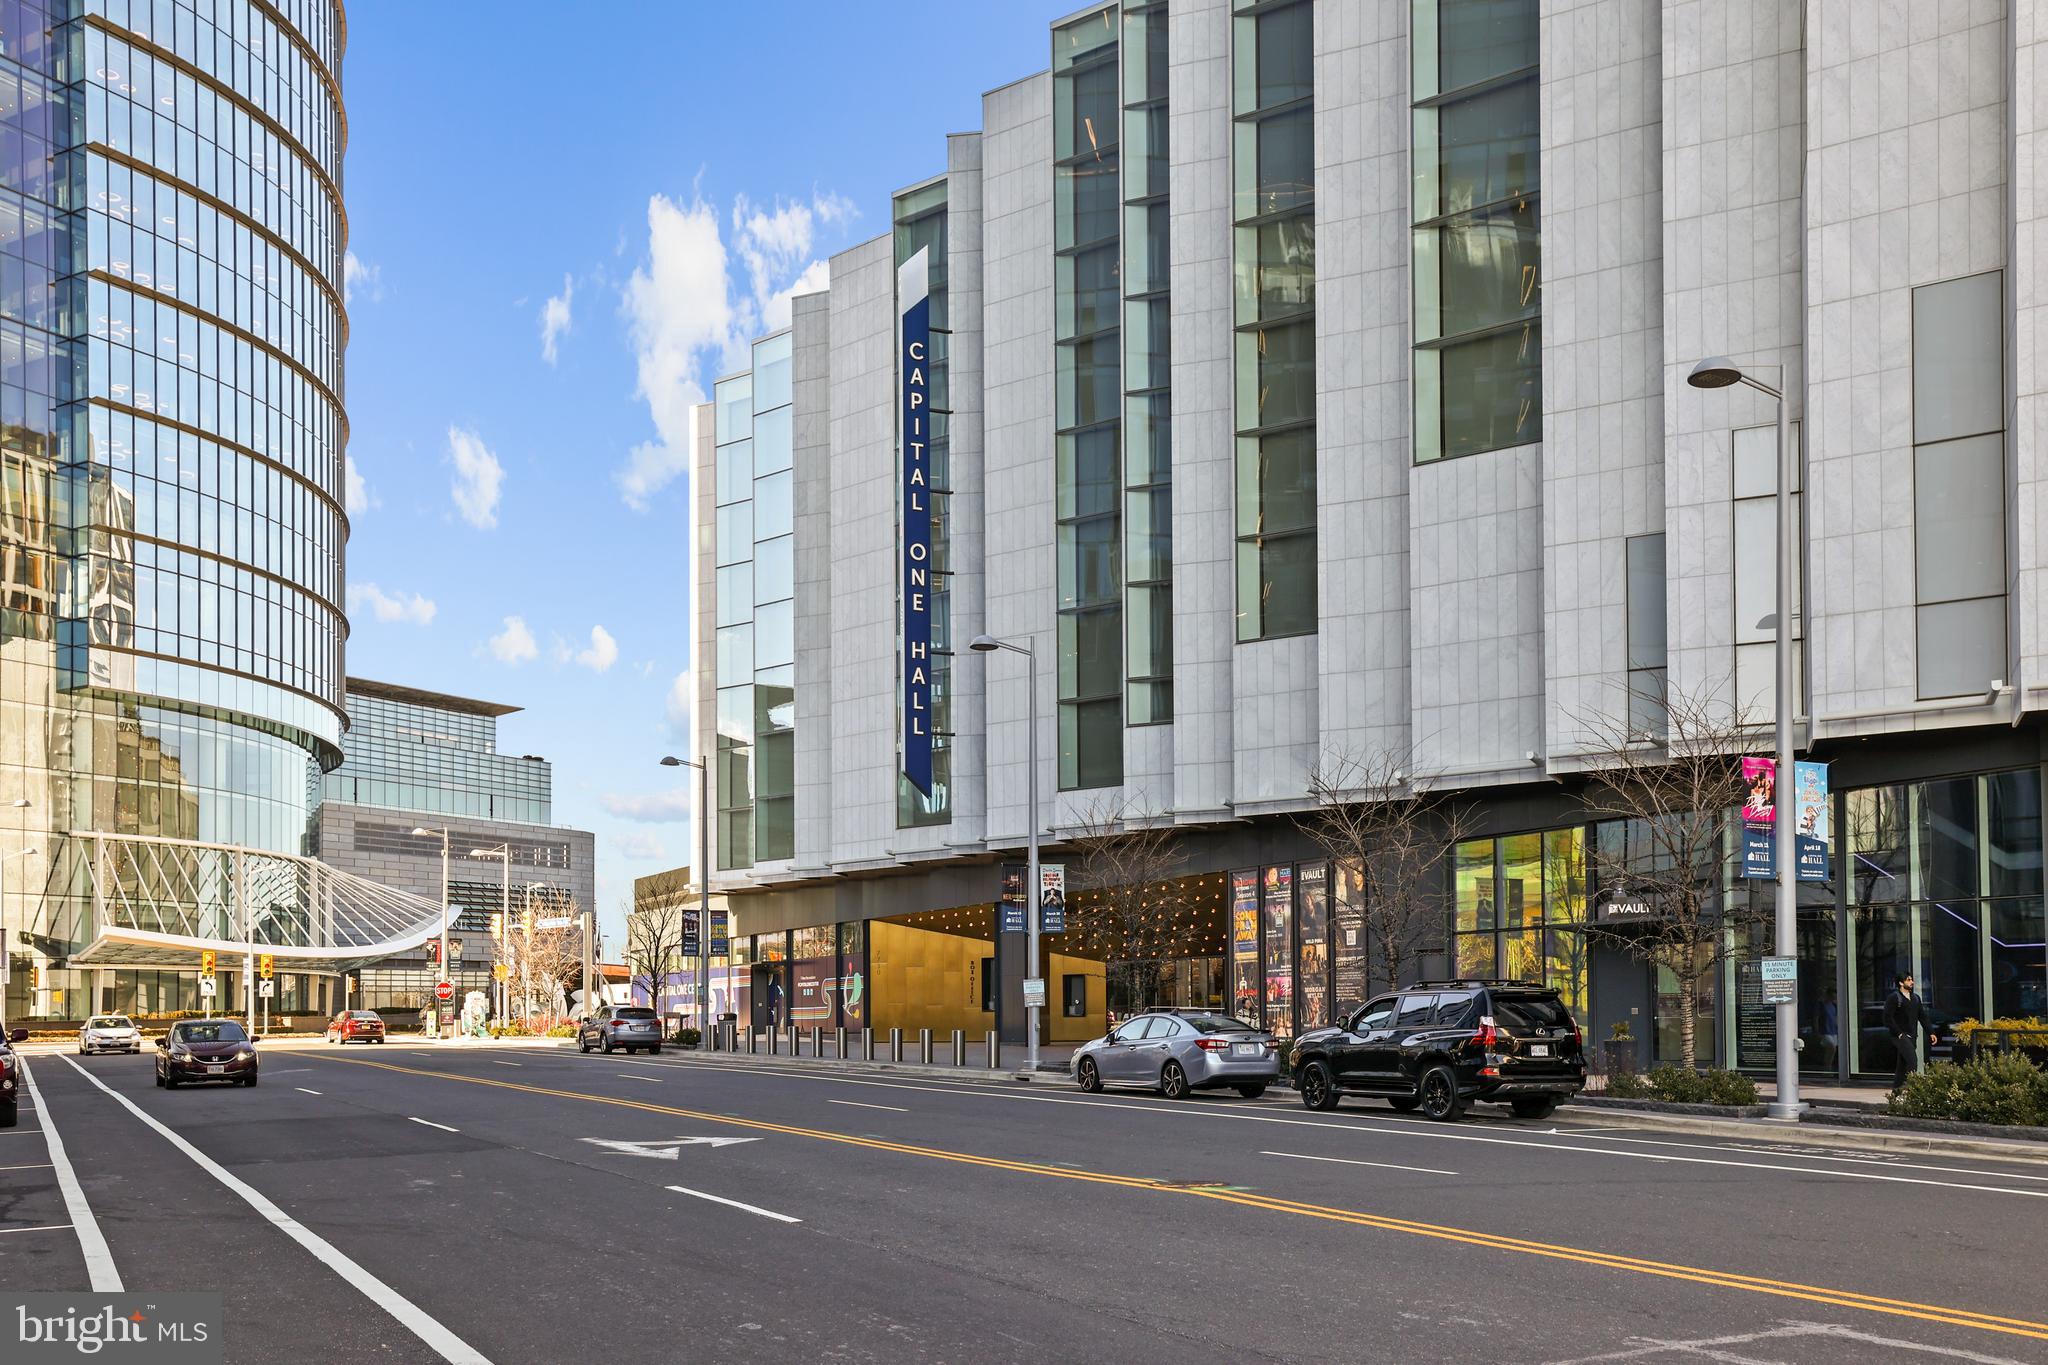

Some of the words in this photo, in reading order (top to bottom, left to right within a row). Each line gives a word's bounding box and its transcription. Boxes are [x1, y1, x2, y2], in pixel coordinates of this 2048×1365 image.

[909, 342, 925, 512] CAPITAL
[909, 542, 927, 612] ONE
[911, 641, 926, 736] HALL
[1304, 869, 1325, 880] VAULT
[1617, 903, 1652, 914] VAULT
[1235, 930, 1257, 941] AWAY
[436, 987, 453, 995] STOP
